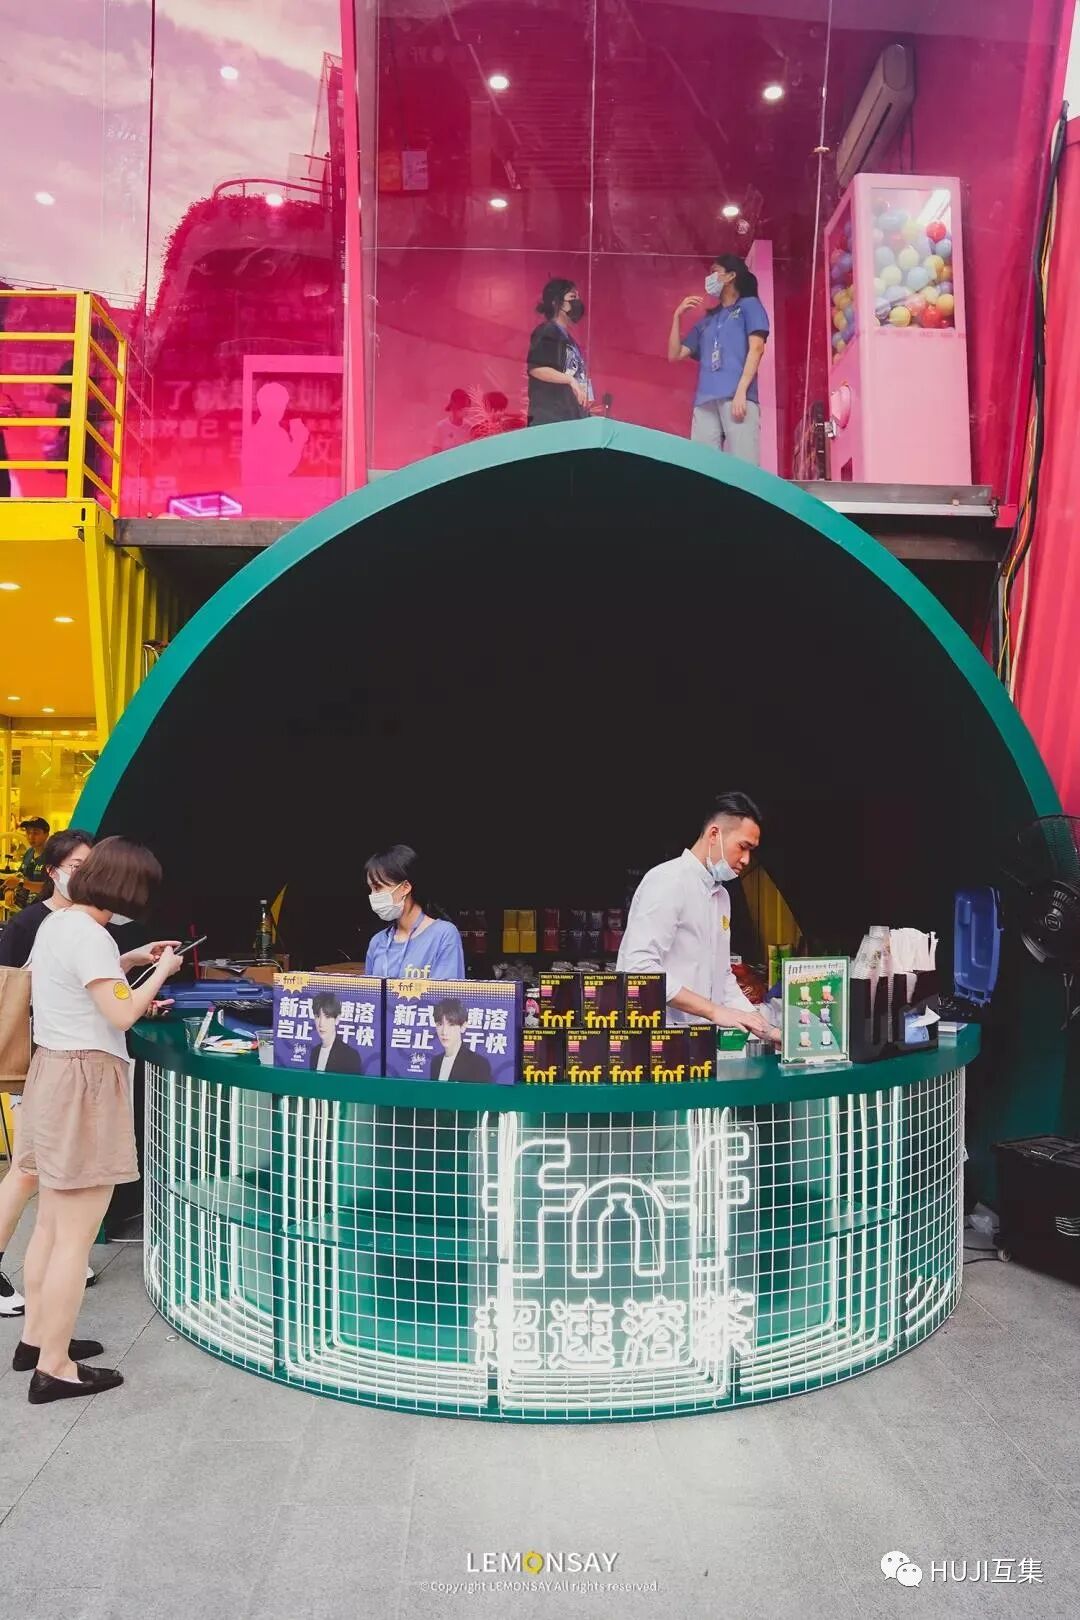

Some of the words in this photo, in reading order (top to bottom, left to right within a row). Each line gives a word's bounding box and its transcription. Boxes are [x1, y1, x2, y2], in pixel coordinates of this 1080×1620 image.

[405, 964, 431, 979] fnf
[398, 982, 413, 991] fnf
[279, 997, 315, 1019] 新式
[393, 1004, 436, 1027] 新式
[540, 1010, 575, 1028] fnf
[584, 1010, 618, 1028] fnf
[627, 1010, 661, 1028] fnf
[277, 1020, 313, 1040] 岂止
[390, 1028, 434, 1050] 岂止
[523, 1065, 557, 1083] fnf
[567, 1065, 602, 1083] fnf
[609, 1065, 643, 1083] fnf
[651, 1064, 685, 1083] fnf
[690, 1060, 712, 1078] nf
